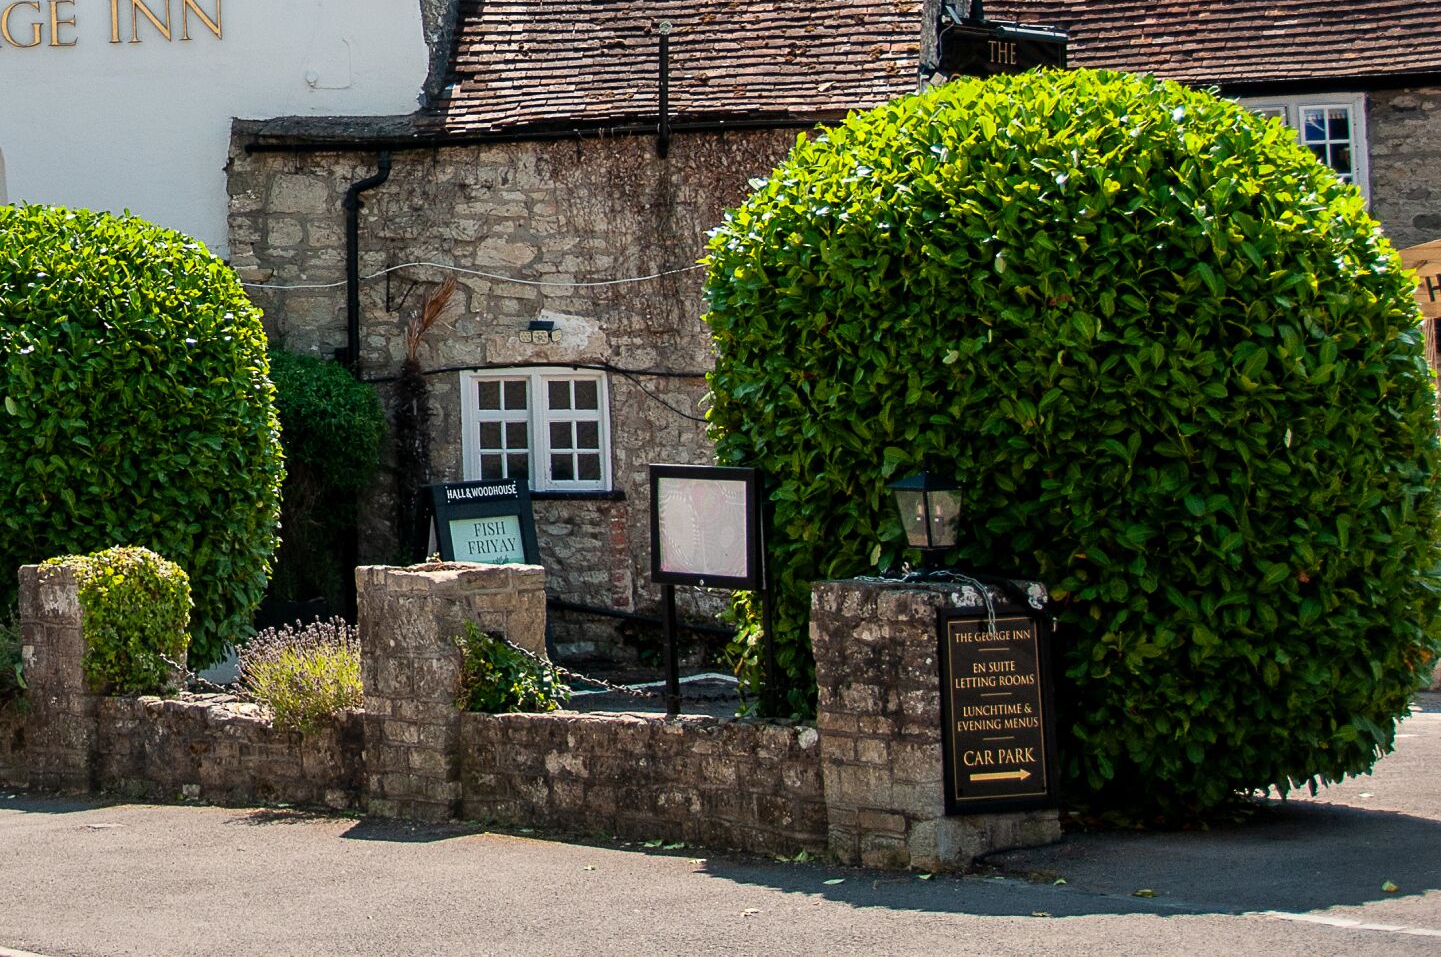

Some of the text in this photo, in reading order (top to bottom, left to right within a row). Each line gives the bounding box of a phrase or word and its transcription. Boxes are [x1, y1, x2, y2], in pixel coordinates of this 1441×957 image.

[988, 40, 1017, 65] THE
[473, 521, 506, 537] FISH
[467, 537, 516, 555] FRIYAY
[954, 629, 1031, 643] THE GEORGE INN
[973, 660, 1016, 674] EN SUITE
[955, 673, 1035, 689] LETTING ROOMS
[963, 703, 1032, 717] LUNCHTIME &
[957, 716, 1039, 732] EVENING MENUS
[963, 747, 1036, 766] CAR PARK
